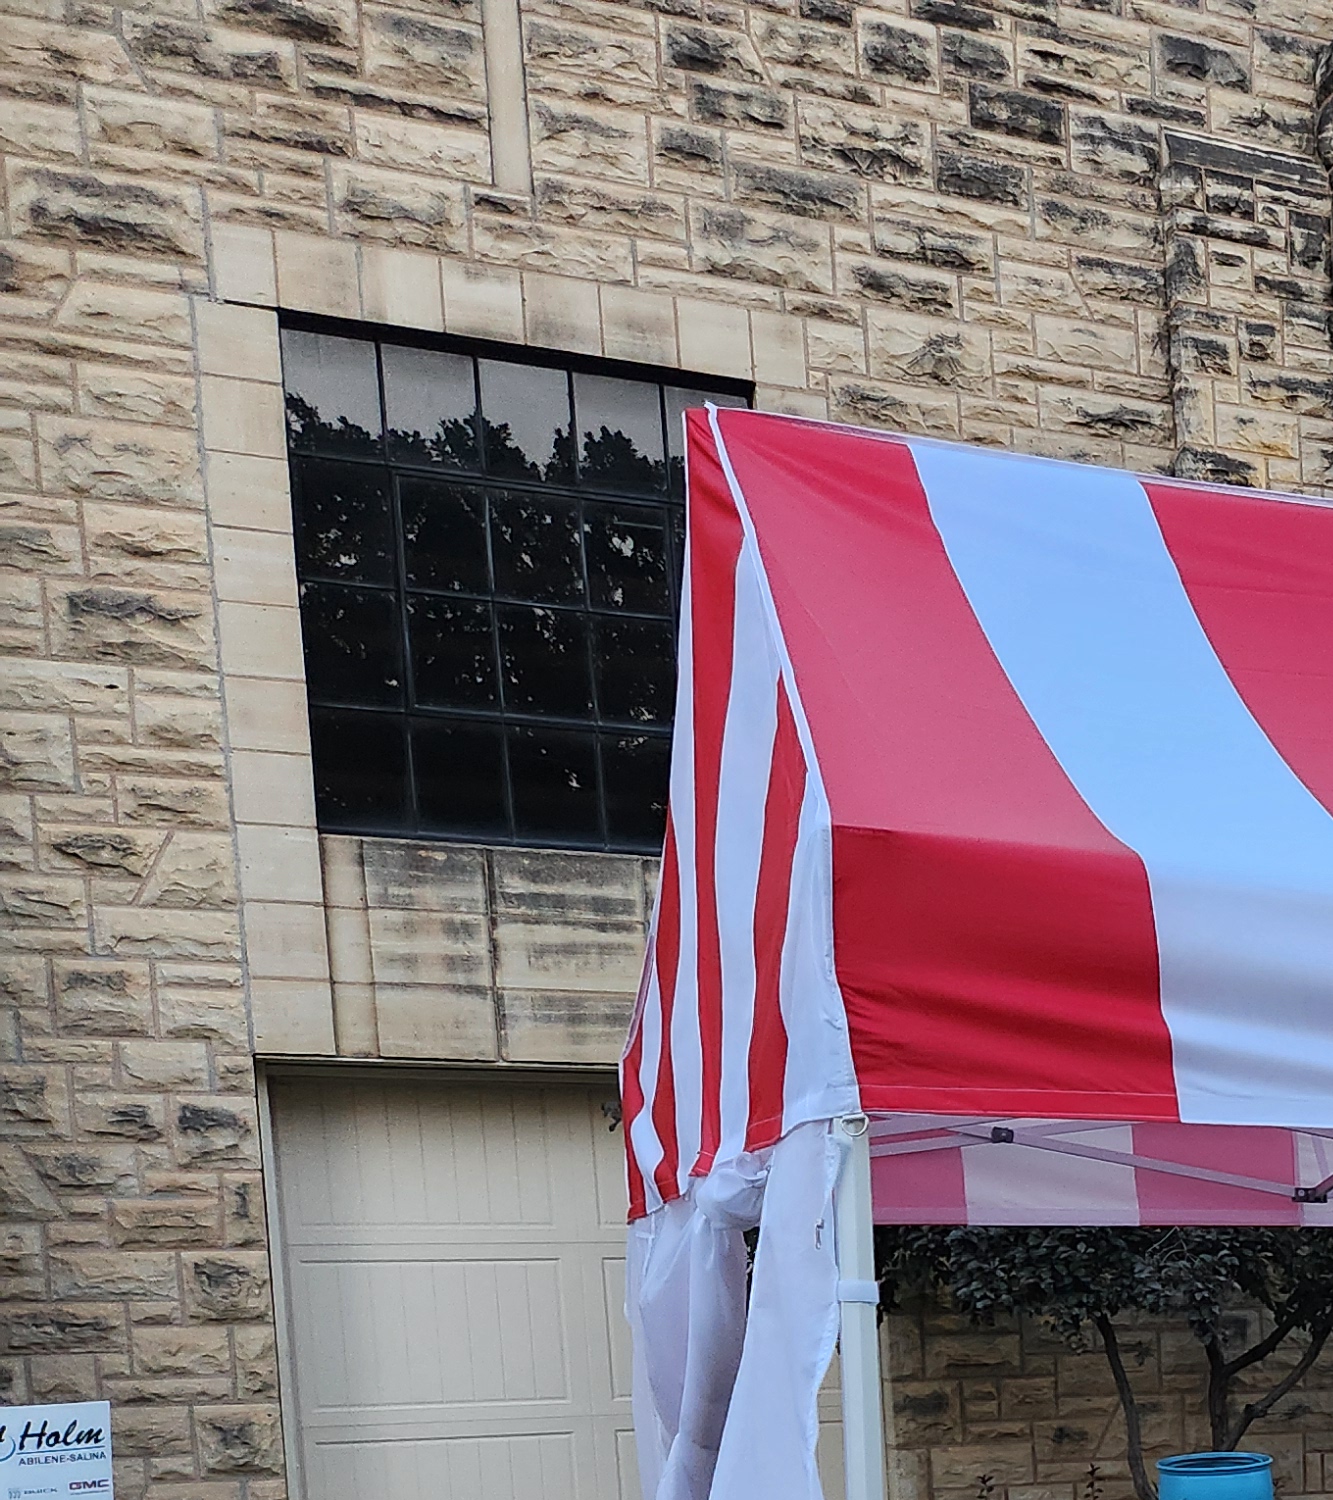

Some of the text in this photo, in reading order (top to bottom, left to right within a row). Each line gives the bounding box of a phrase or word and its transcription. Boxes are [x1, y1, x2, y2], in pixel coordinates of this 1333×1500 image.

[19, 1420, 105, 1450] Holm
[18, 1452, 107, 1466] ABILENE-SALINA
[69, 1479, 110, 1490] GMC
